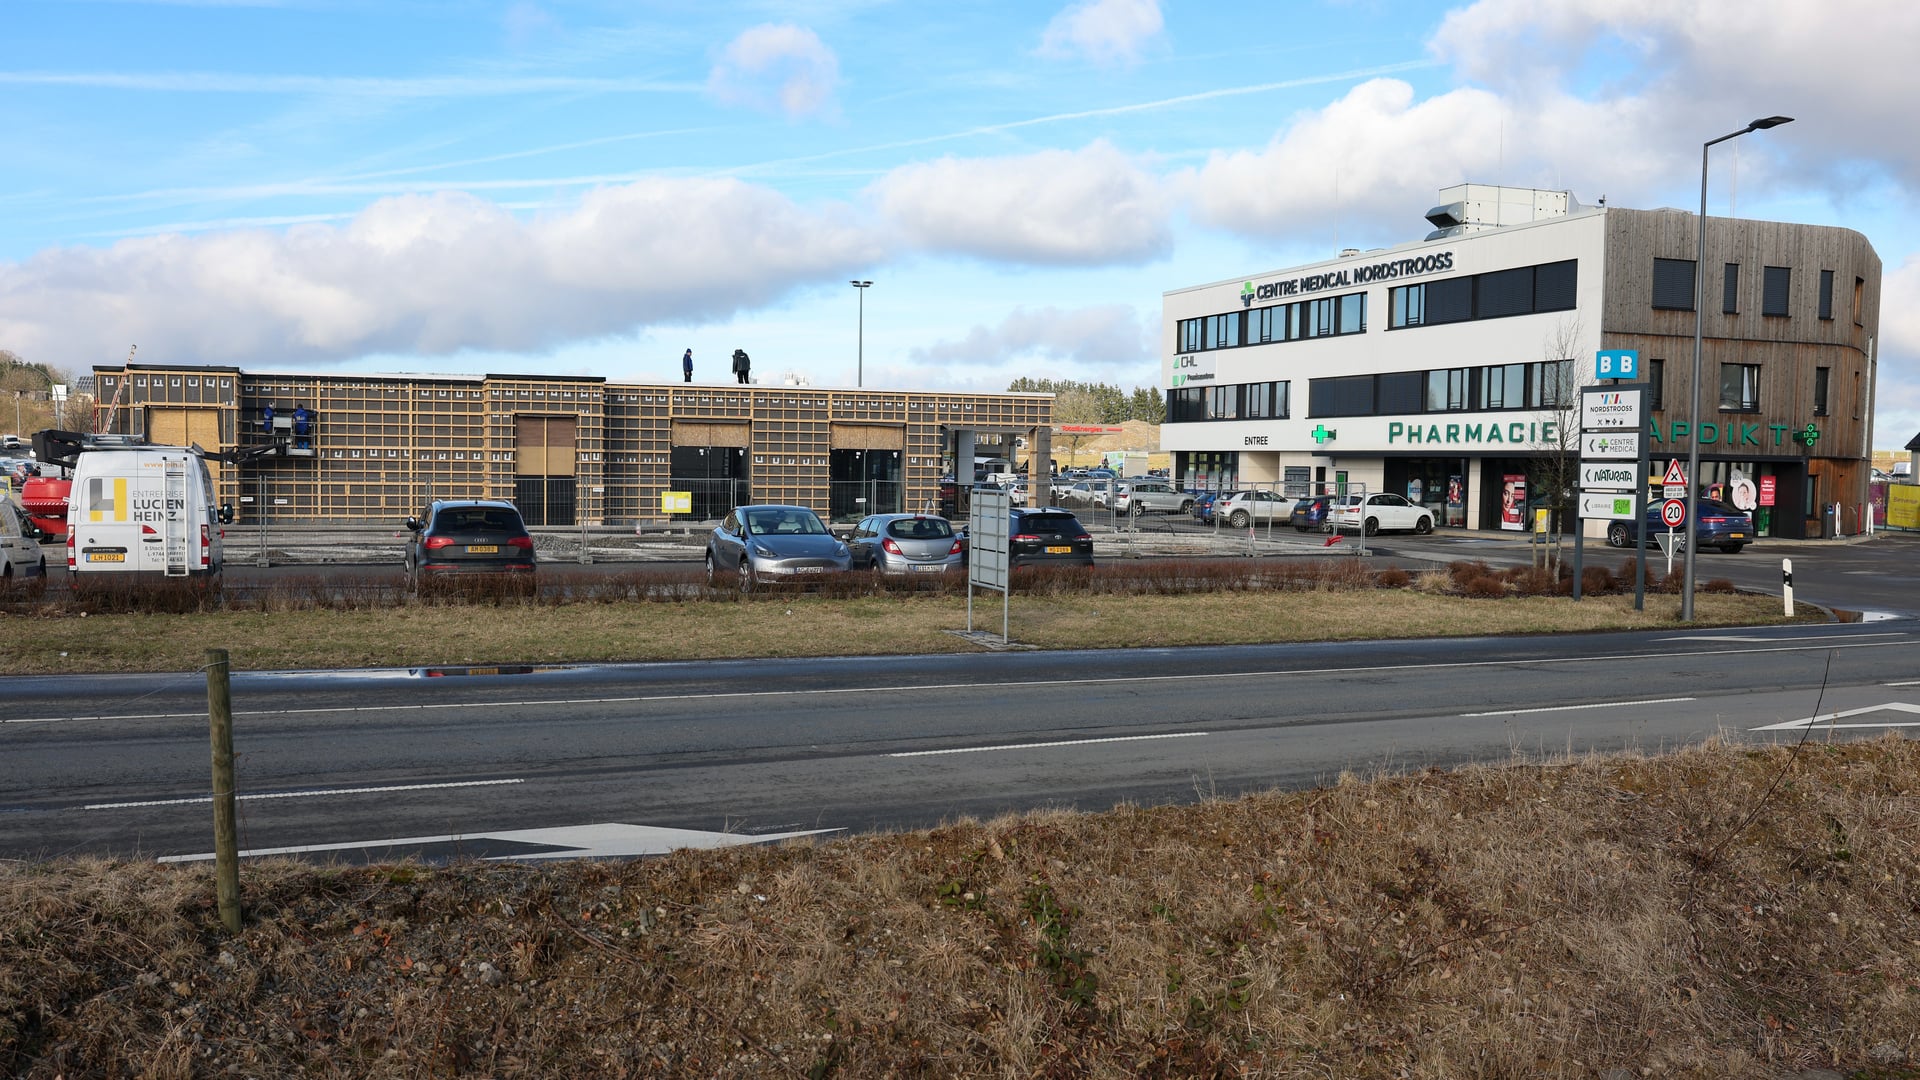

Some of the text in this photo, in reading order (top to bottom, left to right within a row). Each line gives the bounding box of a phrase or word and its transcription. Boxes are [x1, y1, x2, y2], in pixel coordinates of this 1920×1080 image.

[1257, 251, 1454, 300] CENTRE MEDICAL NORDSTROOSS
[1181, 356, 1198, 368] CHL
[1600, 355, 1633, 373] B B
[1388, 421, 1558, 444] PHARMACIE
[1244, 436, 1268, 446] ENTREE
[1609, 438, 1634, 446] CENTRE
[1594, 468, 1633, 482] NATURATA
[133, 499, 184, 510] LUCIEN
[133, 511, 177, 521] HEINZ
[1667, 506, 1680, 519] 20
